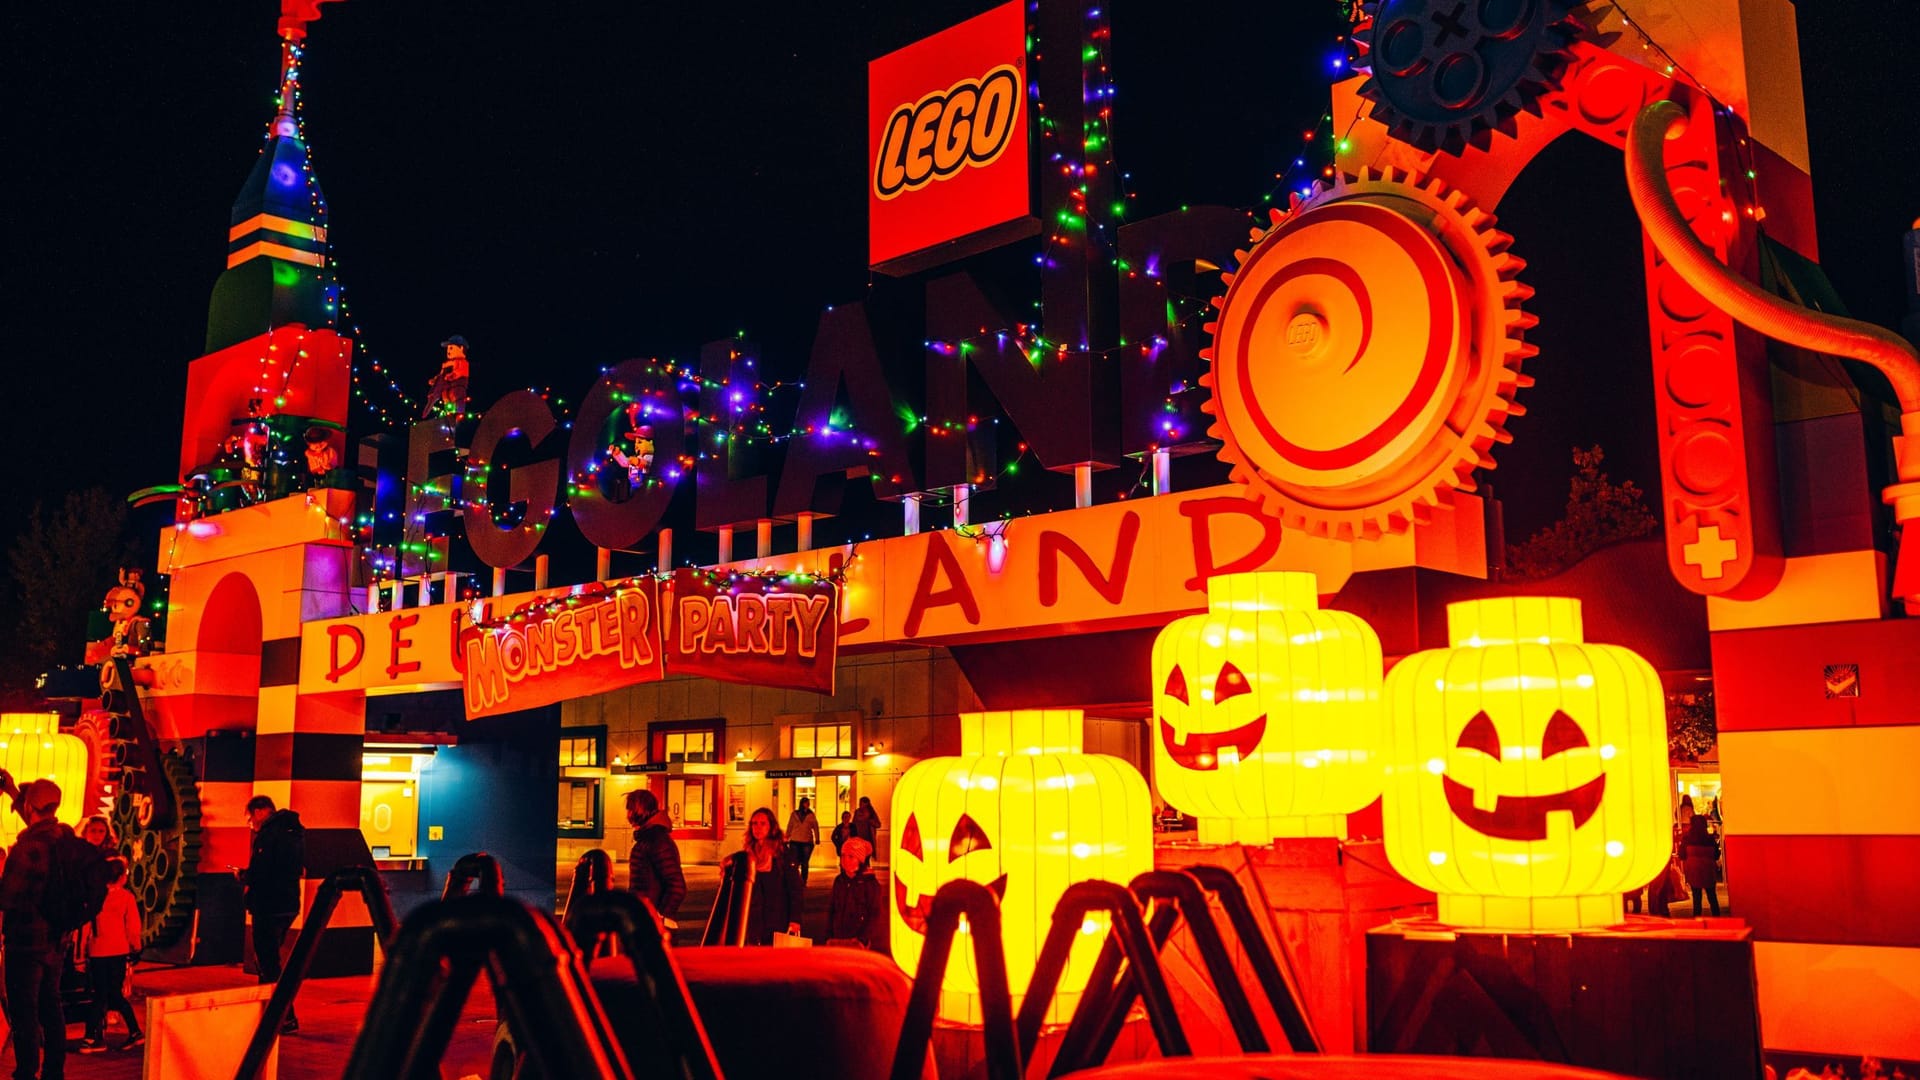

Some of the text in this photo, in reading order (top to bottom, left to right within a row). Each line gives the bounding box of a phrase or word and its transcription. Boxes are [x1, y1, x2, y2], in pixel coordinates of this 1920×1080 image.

[874, 64, 1022, 200] LEGO
[466, 588, 829, 712] MONSTER PARTY
